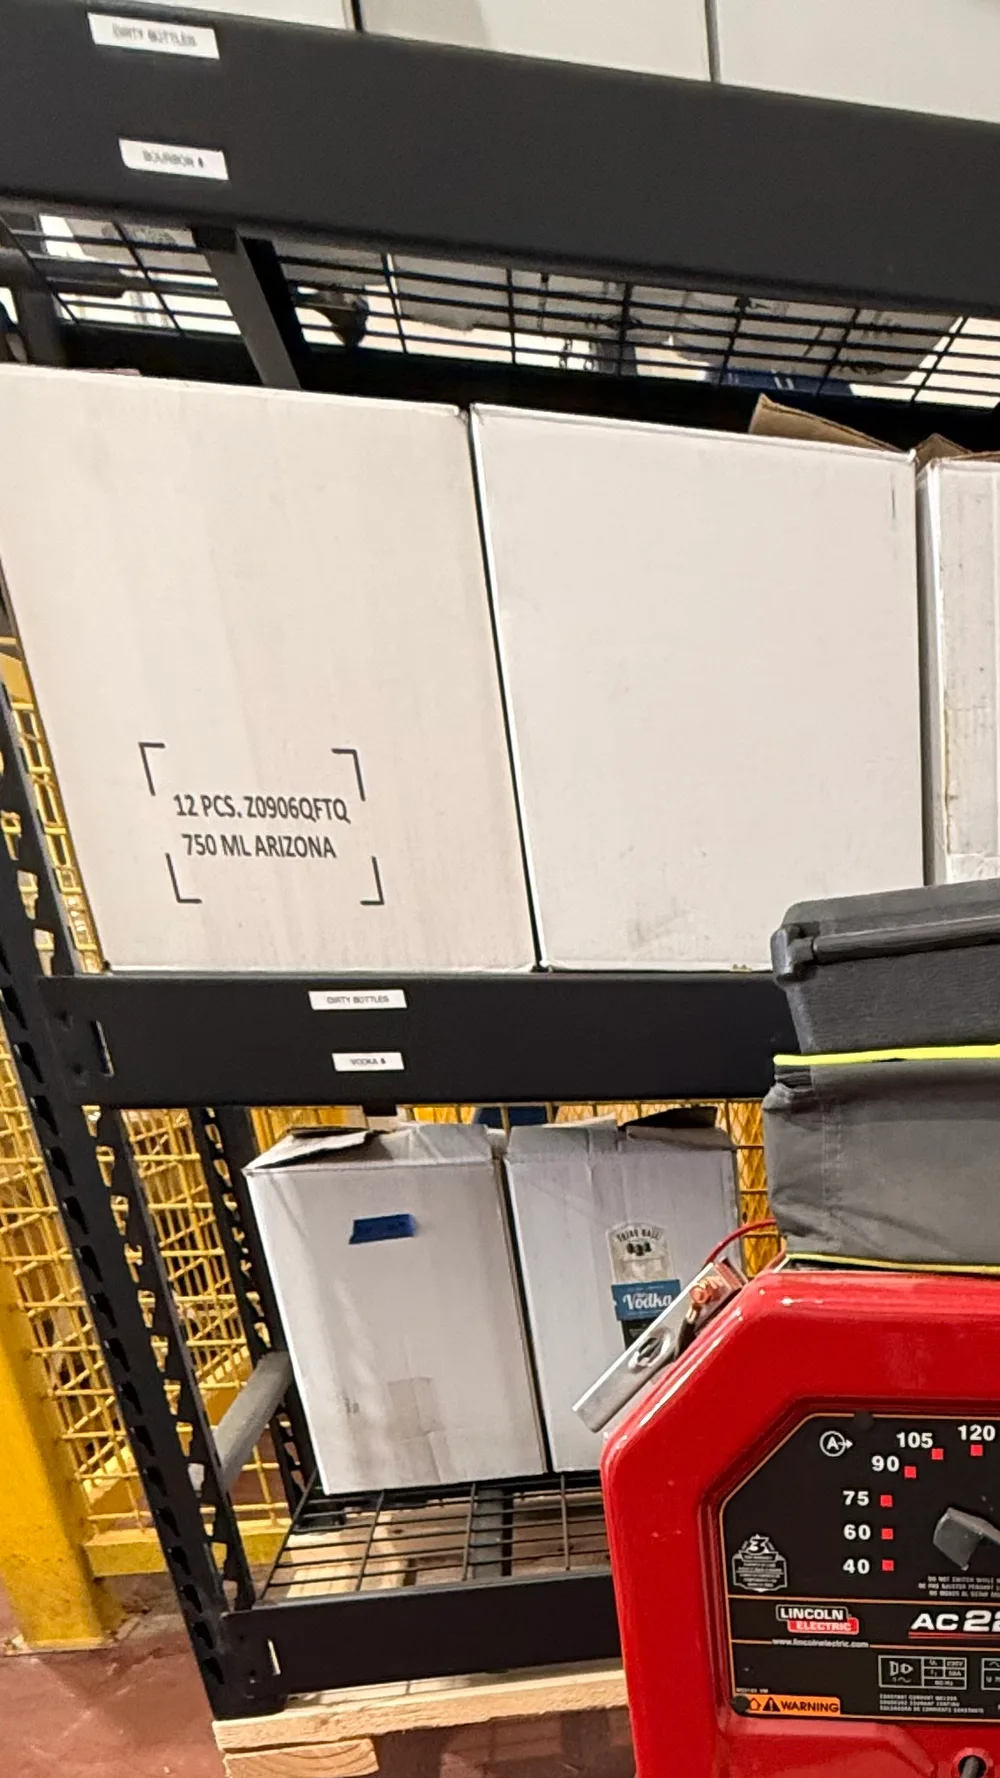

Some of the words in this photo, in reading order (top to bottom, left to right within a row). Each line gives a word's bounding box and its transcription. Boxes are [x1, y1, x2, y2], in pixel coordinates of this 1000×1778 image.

[173, 794, 199, 817] 12
[200, 795, 242, 818] PCS.
[243, 796, 351, 824] Z0906QFTQ
[181, 834, 217, 856] 750
[219, 835, 252, 857] ML
[254, 835, 338, 859] ARIZONA
[622, 1293, 672, 1310] Vodka
[896, 1431, 933, 1449] 105
[957, 1424, 996, 1442] 120
[871, 1455, 900, 1473] 90
[842, 1490, 870, 1507] 75
[843, 1524, 871, 1541] 60
[842, 1558, 870, 1575] 40
[780, 1607, 844, 1621] LINCOLN
[796, 1620, 852, 1632] ELECTRIC
[772, 1638, 869, 1649] www.lincolnelectric.com
[780, 1701, 839, 1714] WARNING
